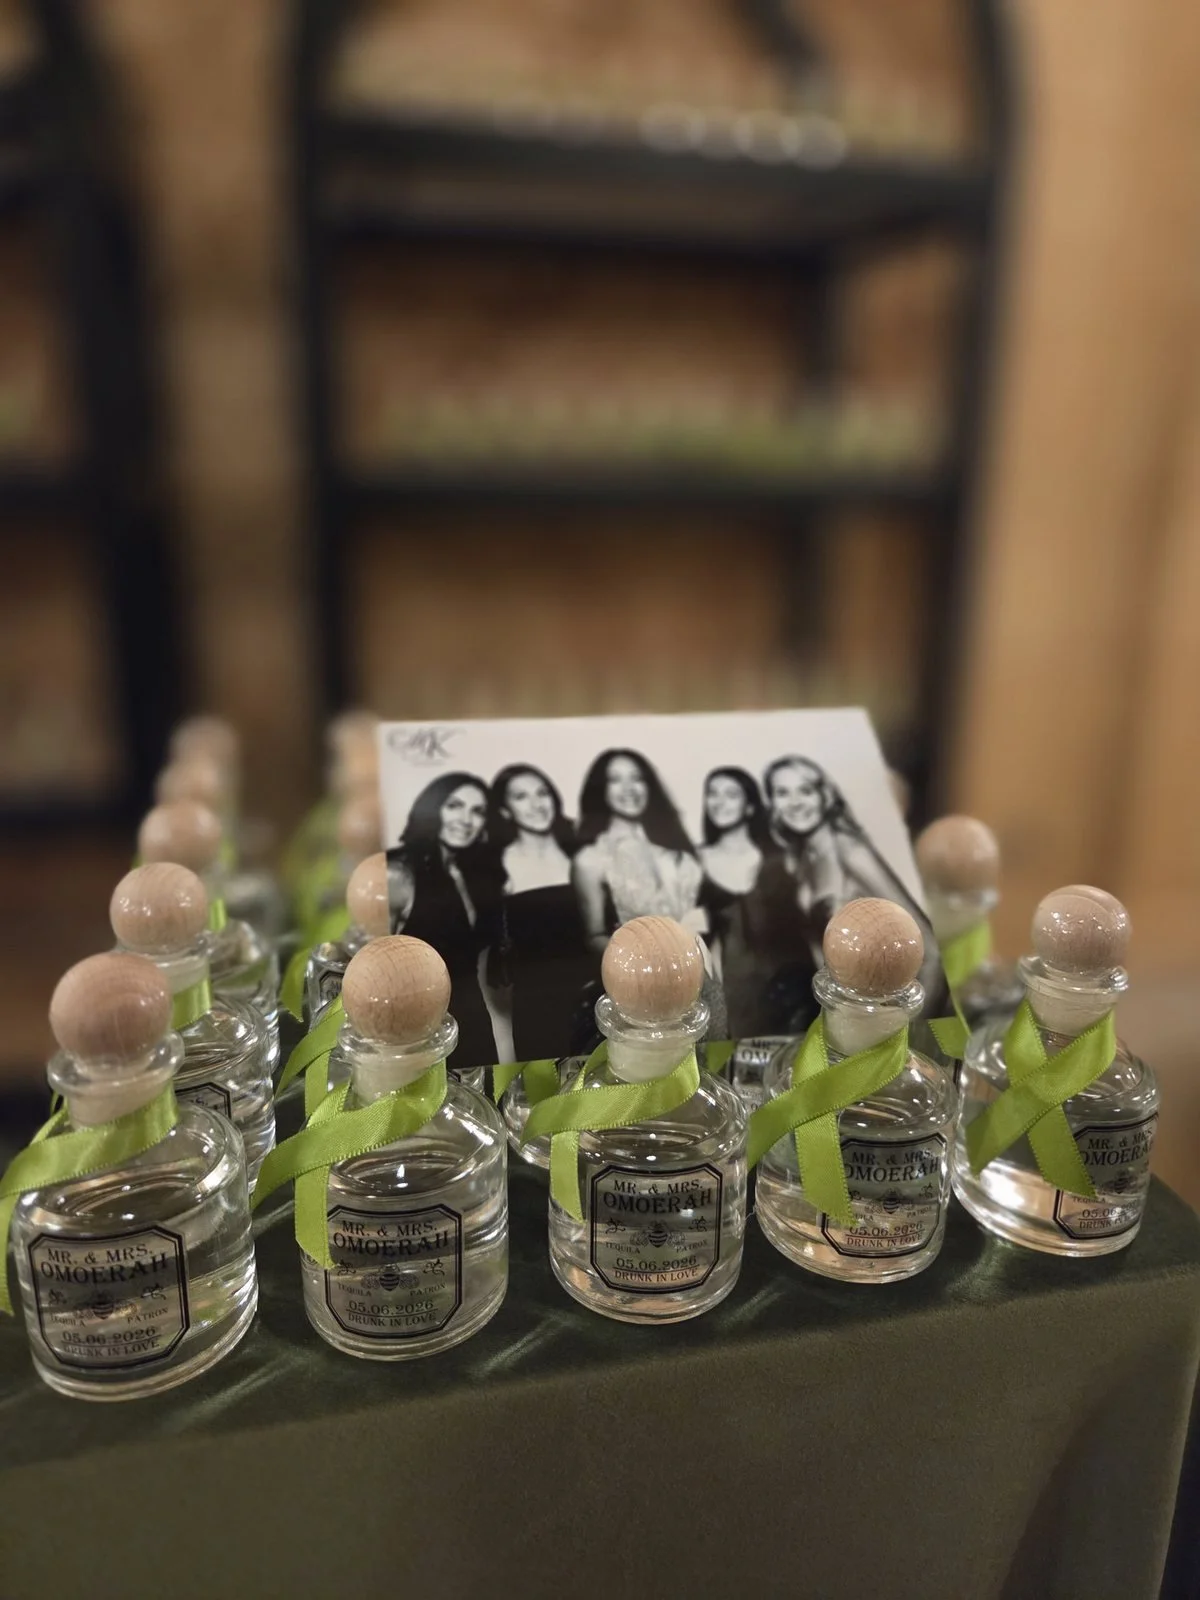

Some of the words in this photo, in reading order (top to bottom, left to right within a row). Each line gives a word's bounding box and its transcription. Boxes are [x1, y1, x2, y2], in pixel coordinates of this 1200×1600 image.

[852, 1152, 880, 1166] MR.
[886, 1154, 897, 1165] &
[614, 1180, 641, 1194] MR.
[648, 1184, 659, 1194] &
[667, 1179, 703, 1194] MRS.
[603, 1188, 712, 1214] OMOERAH
[342, 1220, 370, 1236] MR.
[377, 1224, 388, 1236] &
[397, 1221, 438, 1236] MRS.
[333, 1230, 449, 1256] OMOERAH
[847, 1237, 884, 1248] DRUNK
[887, 1239, 897, 1247] IN
[47, 1248, 78, 1265] MR.
[84, 1251, 97, 1265] &
[106, 1243, 153, 1263] MRS.
[40, 1252, 168, 1284] OMOERAH
[616, 1256, 697, 1271] 05.06.2026
[615, 1270, 652, 1282] DRUNK
[656, 1273, 667, 1282] IN
[669, 1267, 698, 1281] LOVE
[348, 1300, 434, 1315] 05.06.2026
[348, 1313, 385, 1326] DRUNK
[390, 1318, 402, 1326] IN
[405, 1313, 437, 1326] LOVE
[124, 1340, 160, 1355] LOVE
